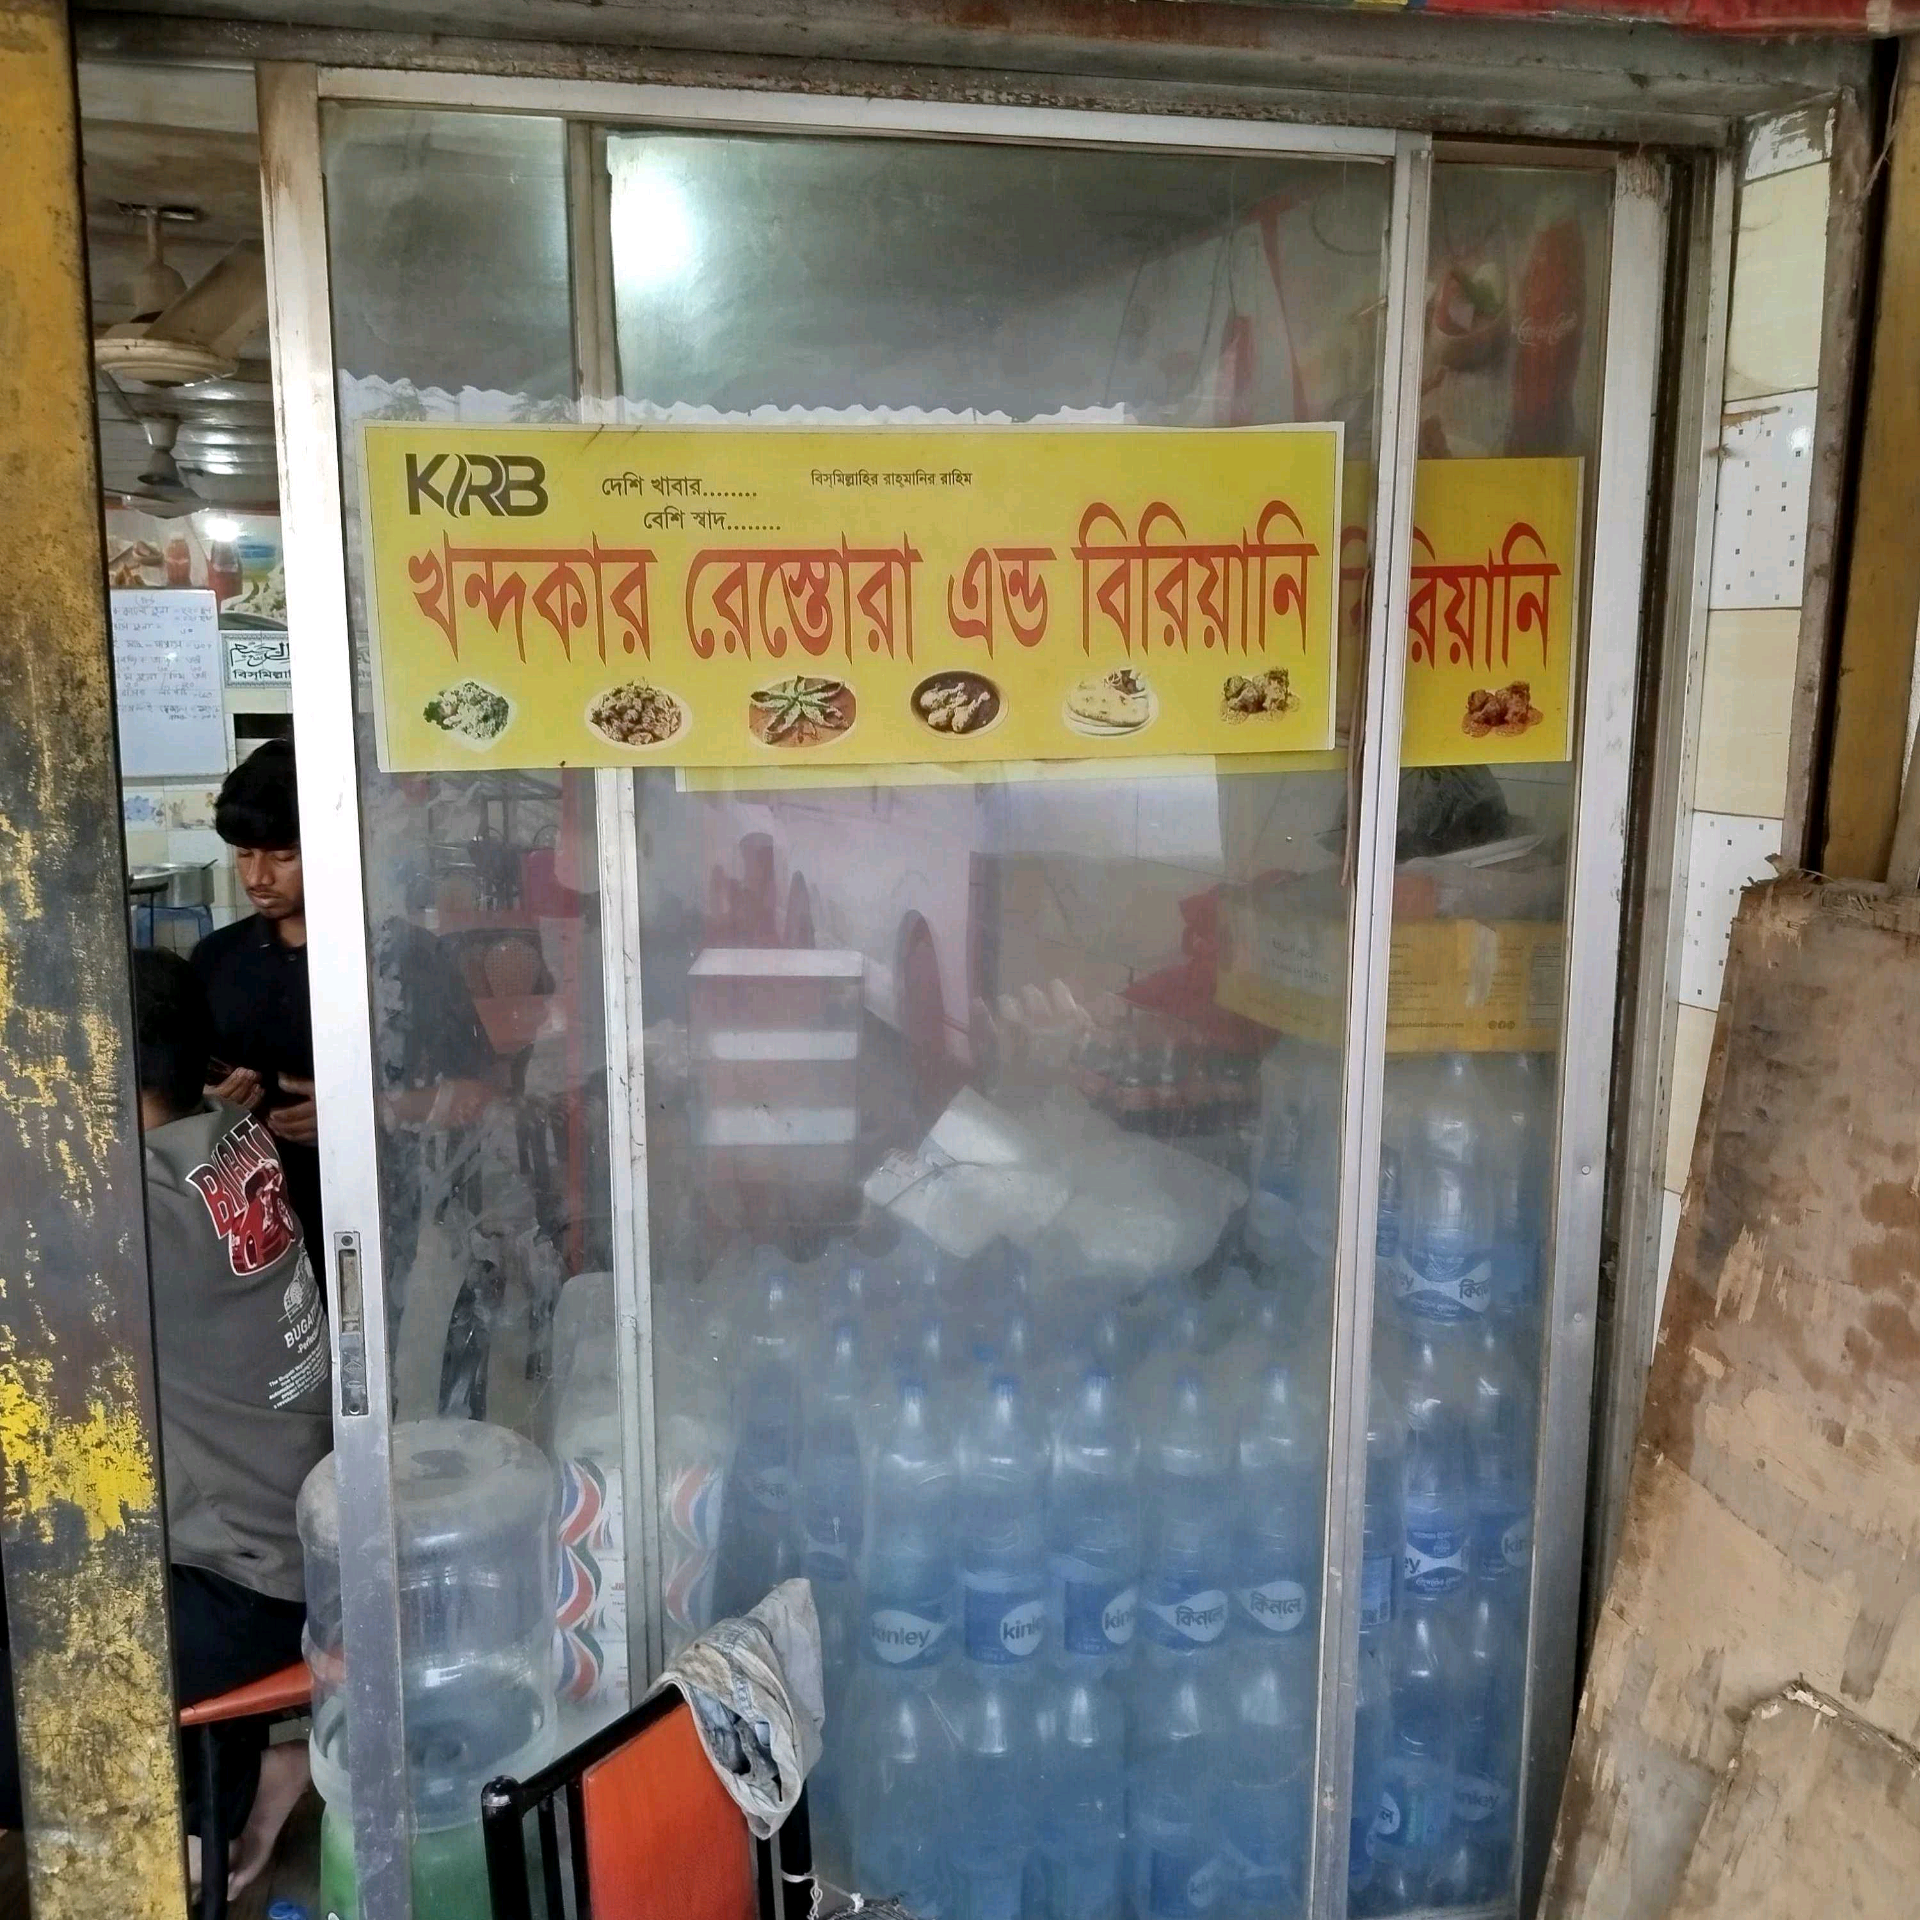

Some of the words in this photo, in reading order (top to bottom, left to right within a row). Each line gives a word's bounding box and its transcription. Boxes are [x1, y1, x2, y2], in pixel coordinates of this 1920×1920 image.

[601, 471, 644, 497] দেশি
[939, 469, 973, 487] রাহিম
[643, 505, 686, 530] বেশি
[408, 529, 658, 665] খন্দকার
[686, 529, 923, 666] রেস্তোরা
[947, 546, 1058, 660] এন্ড
[1070, 499, 1320, 658] বিরিয়ানি
[869, 1621, 931, 1648] kinley
